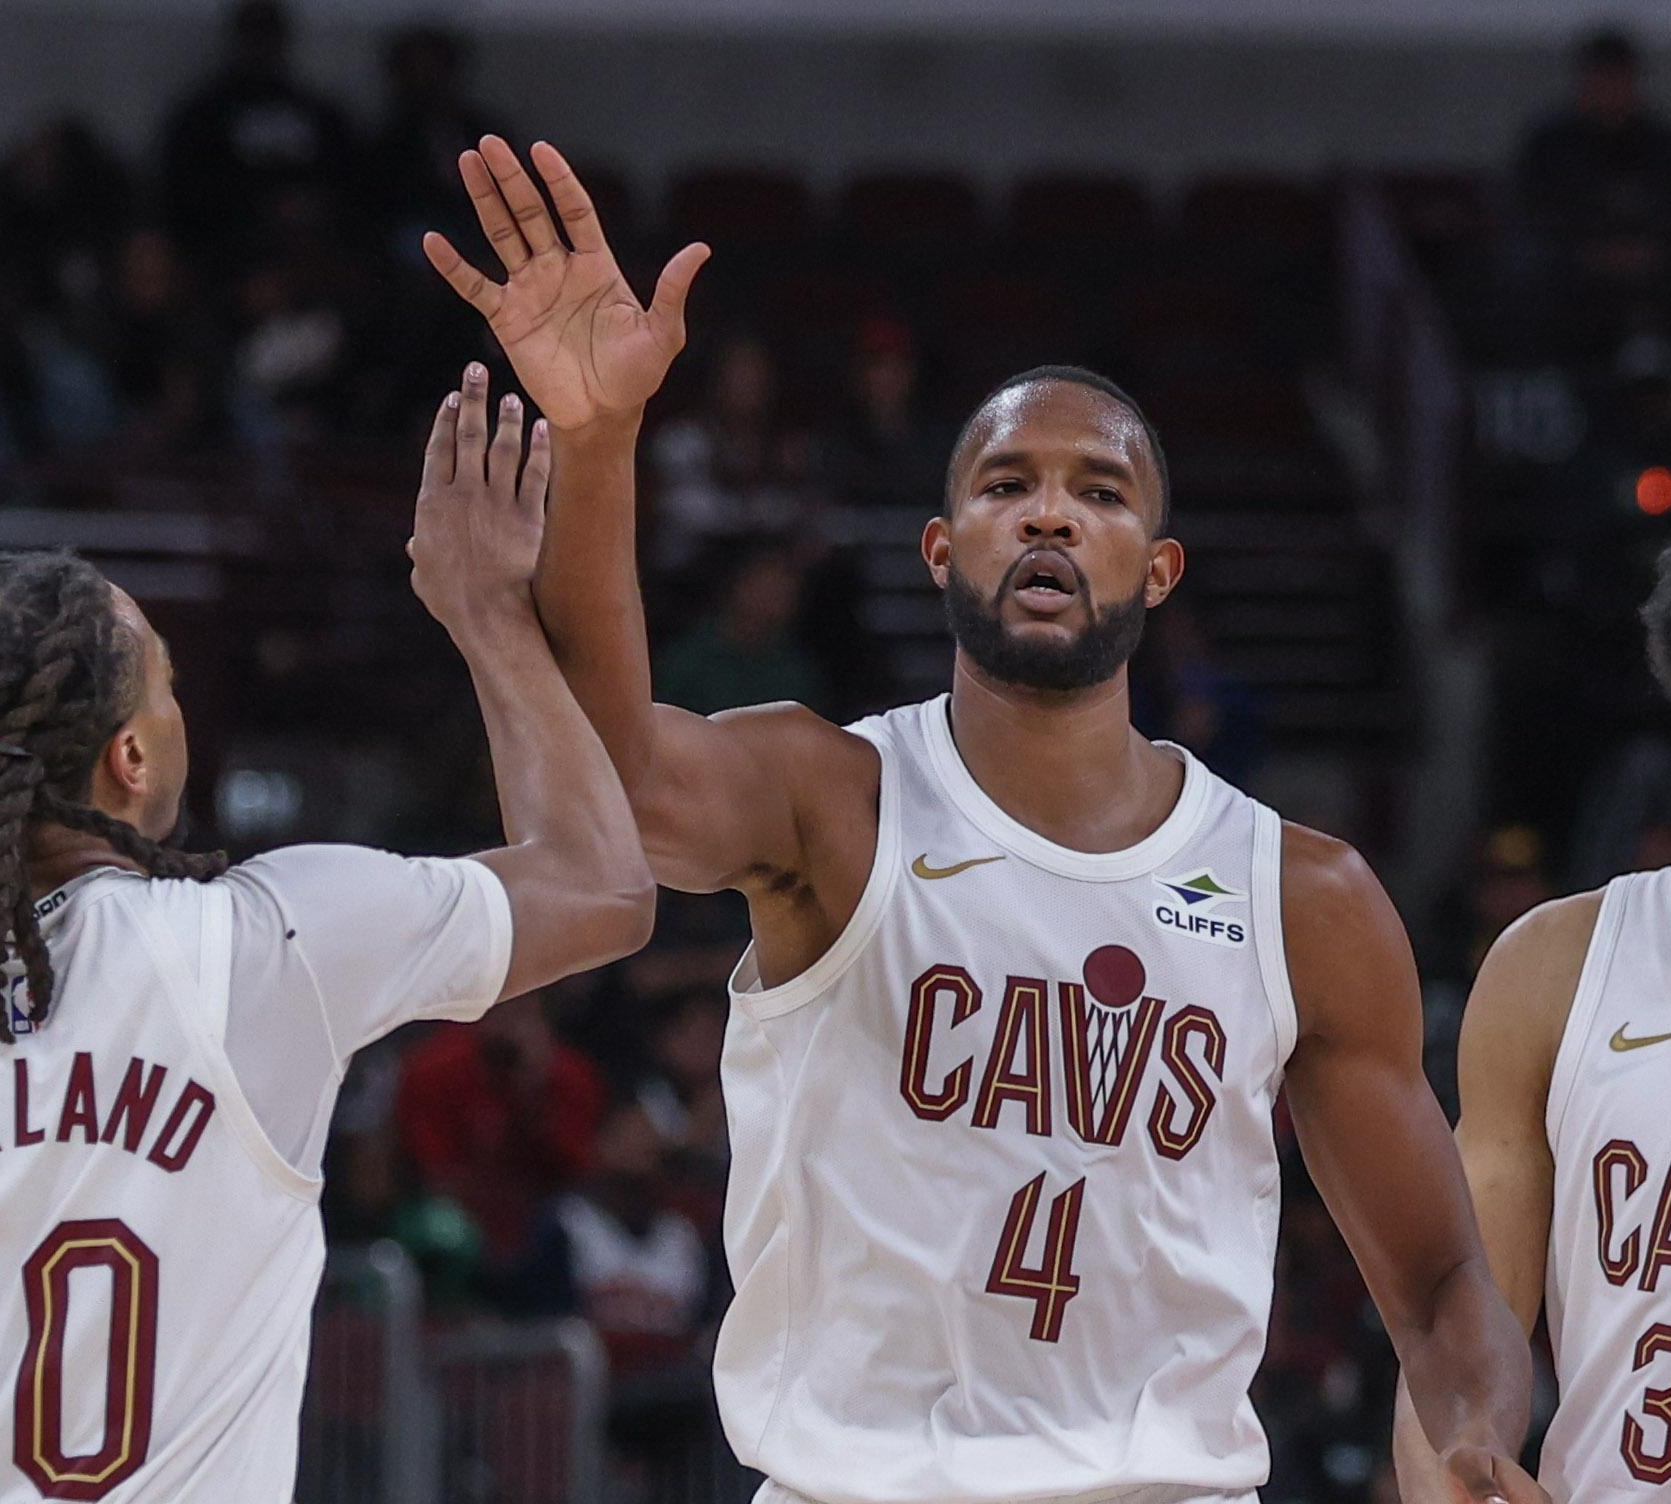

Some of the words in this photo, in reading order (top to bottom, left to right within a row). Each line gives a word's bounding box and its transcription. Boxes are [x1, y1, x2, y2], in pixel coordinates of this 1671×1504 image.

[1155, 906, 1245, 943] CLIFFS
[900, 963, 1227, 1161] CAVS
[985, 1170, 1086, 1343] 4
